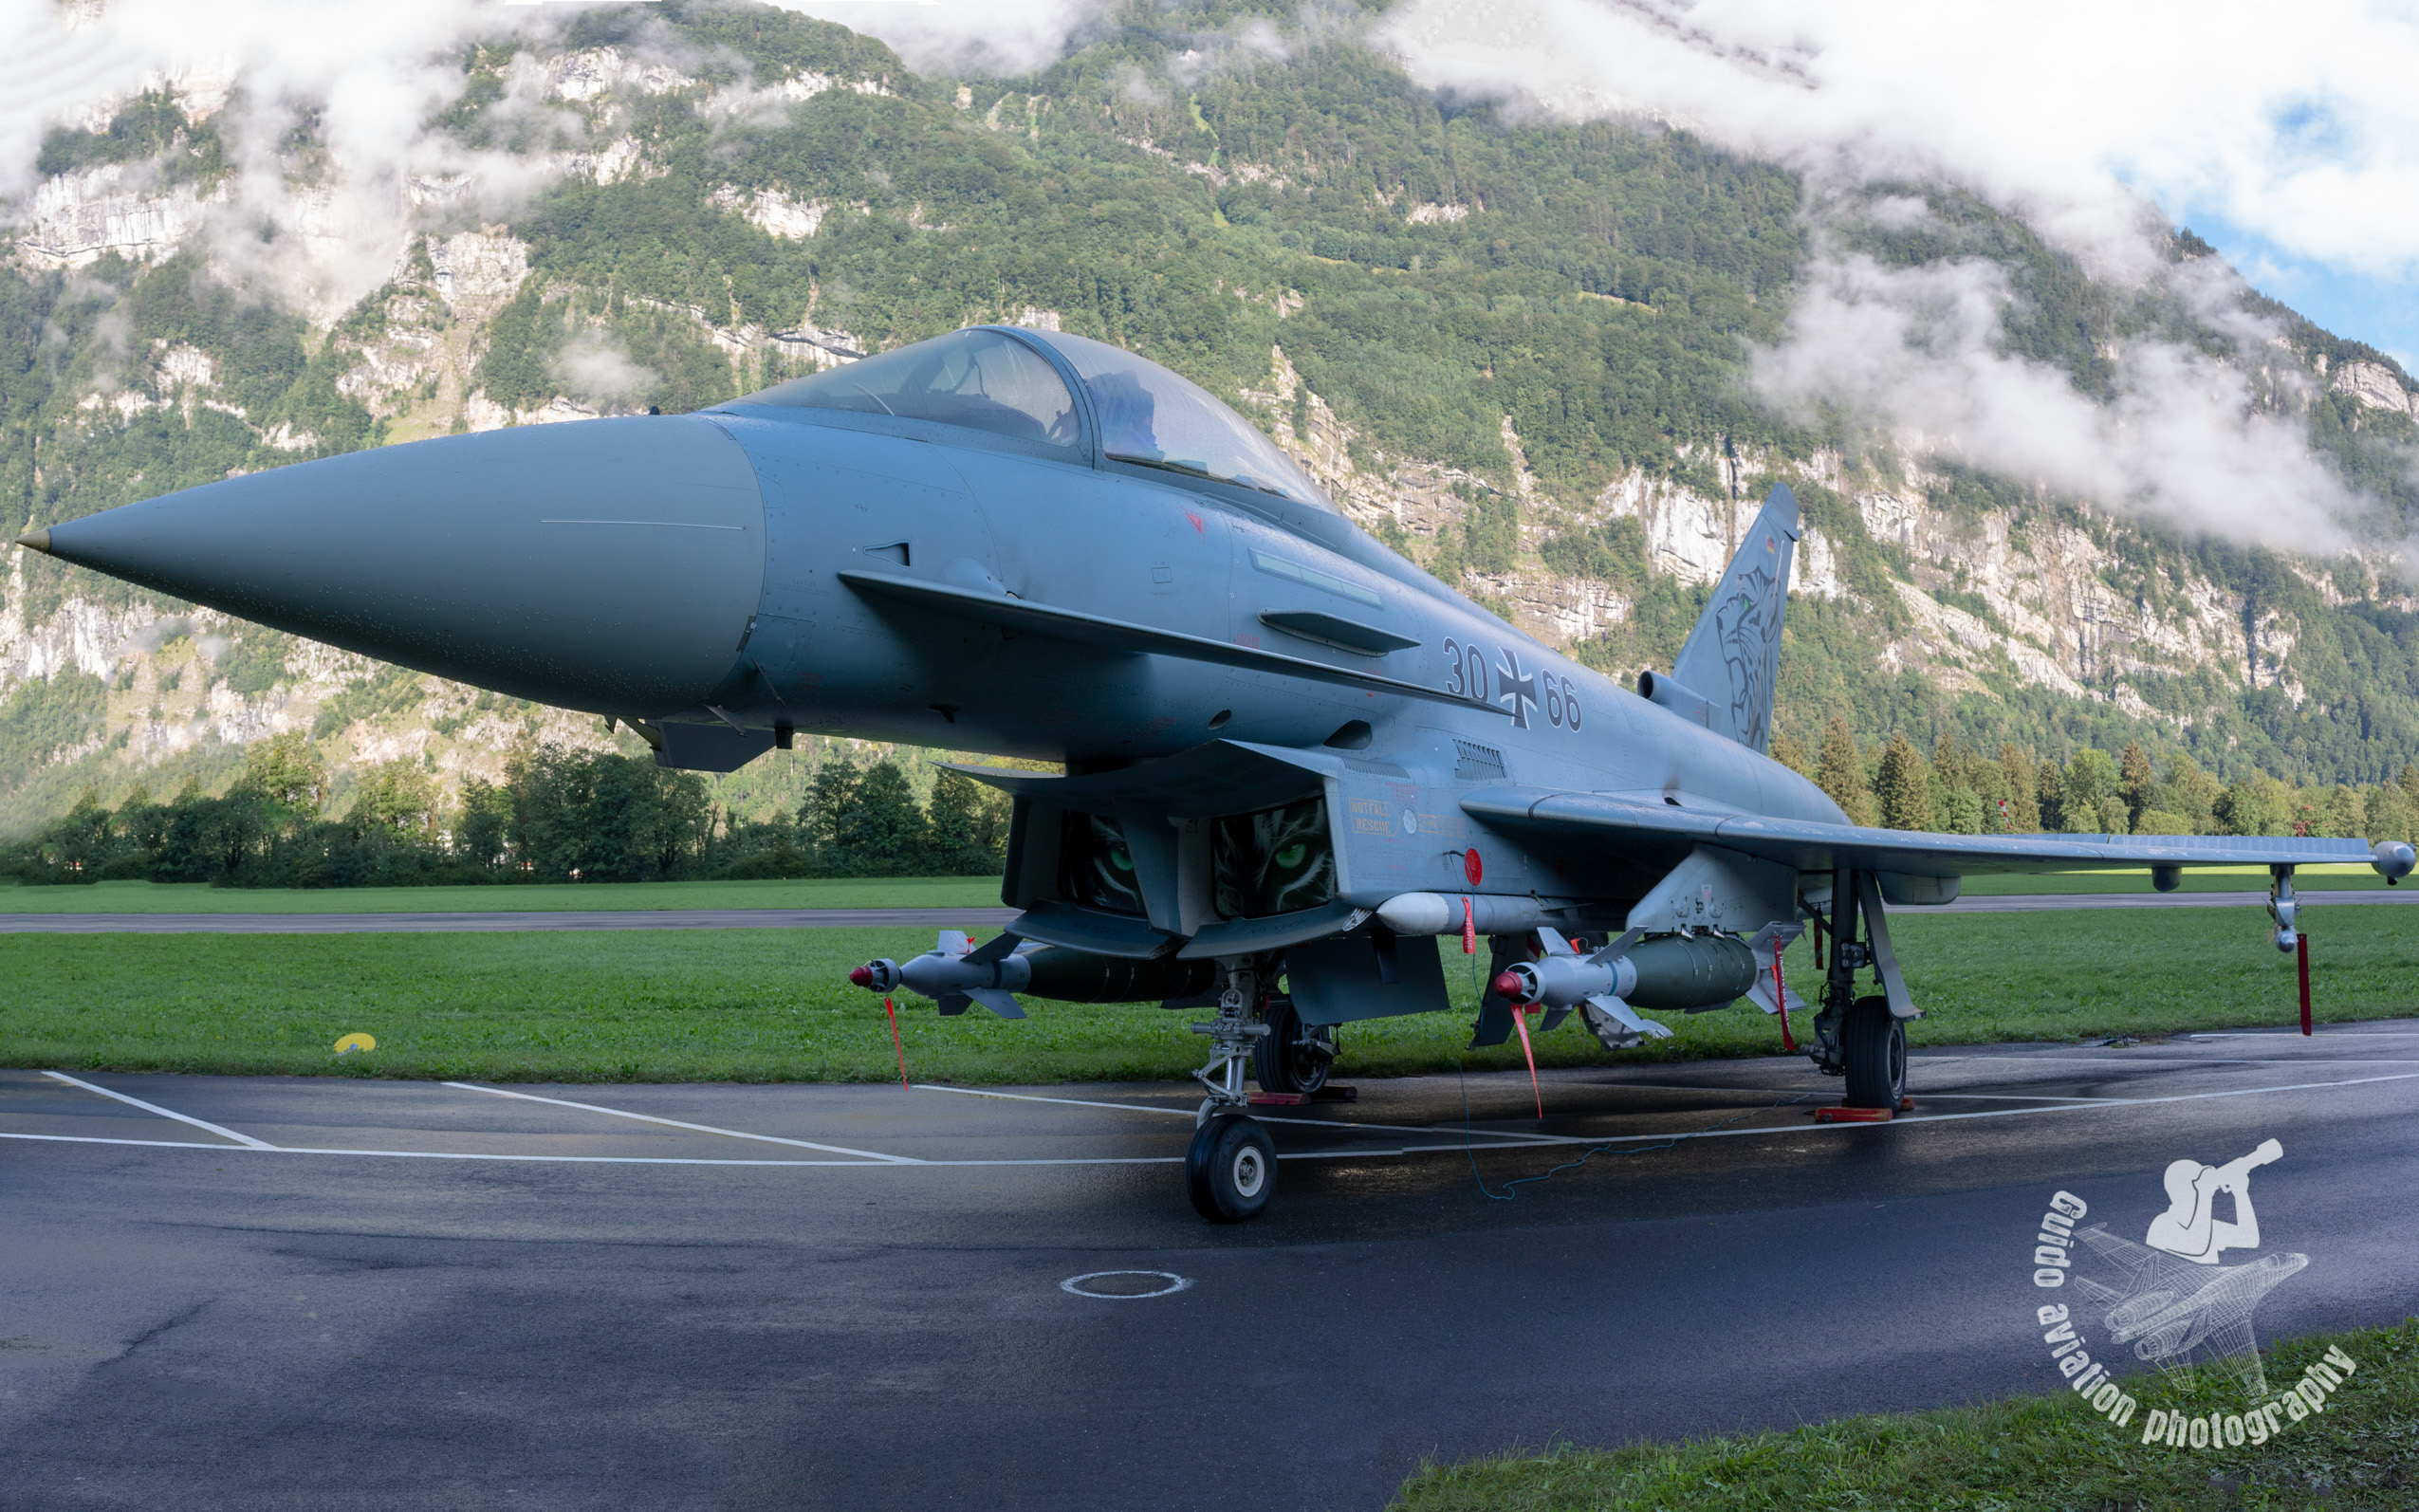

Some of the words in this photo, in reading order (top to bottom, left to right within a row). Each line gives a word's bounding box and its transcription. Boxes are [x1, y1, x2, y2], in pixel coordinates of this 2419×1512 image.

[1443, 636, 1489, 703] 30
[1542, 669, 1581, 732] 66
[1351, 801, 1391, 818] NOTFALL
[1356, 818, 1391, 834] RESCUE
[1465, 917, 1473, 950] REMOVE
